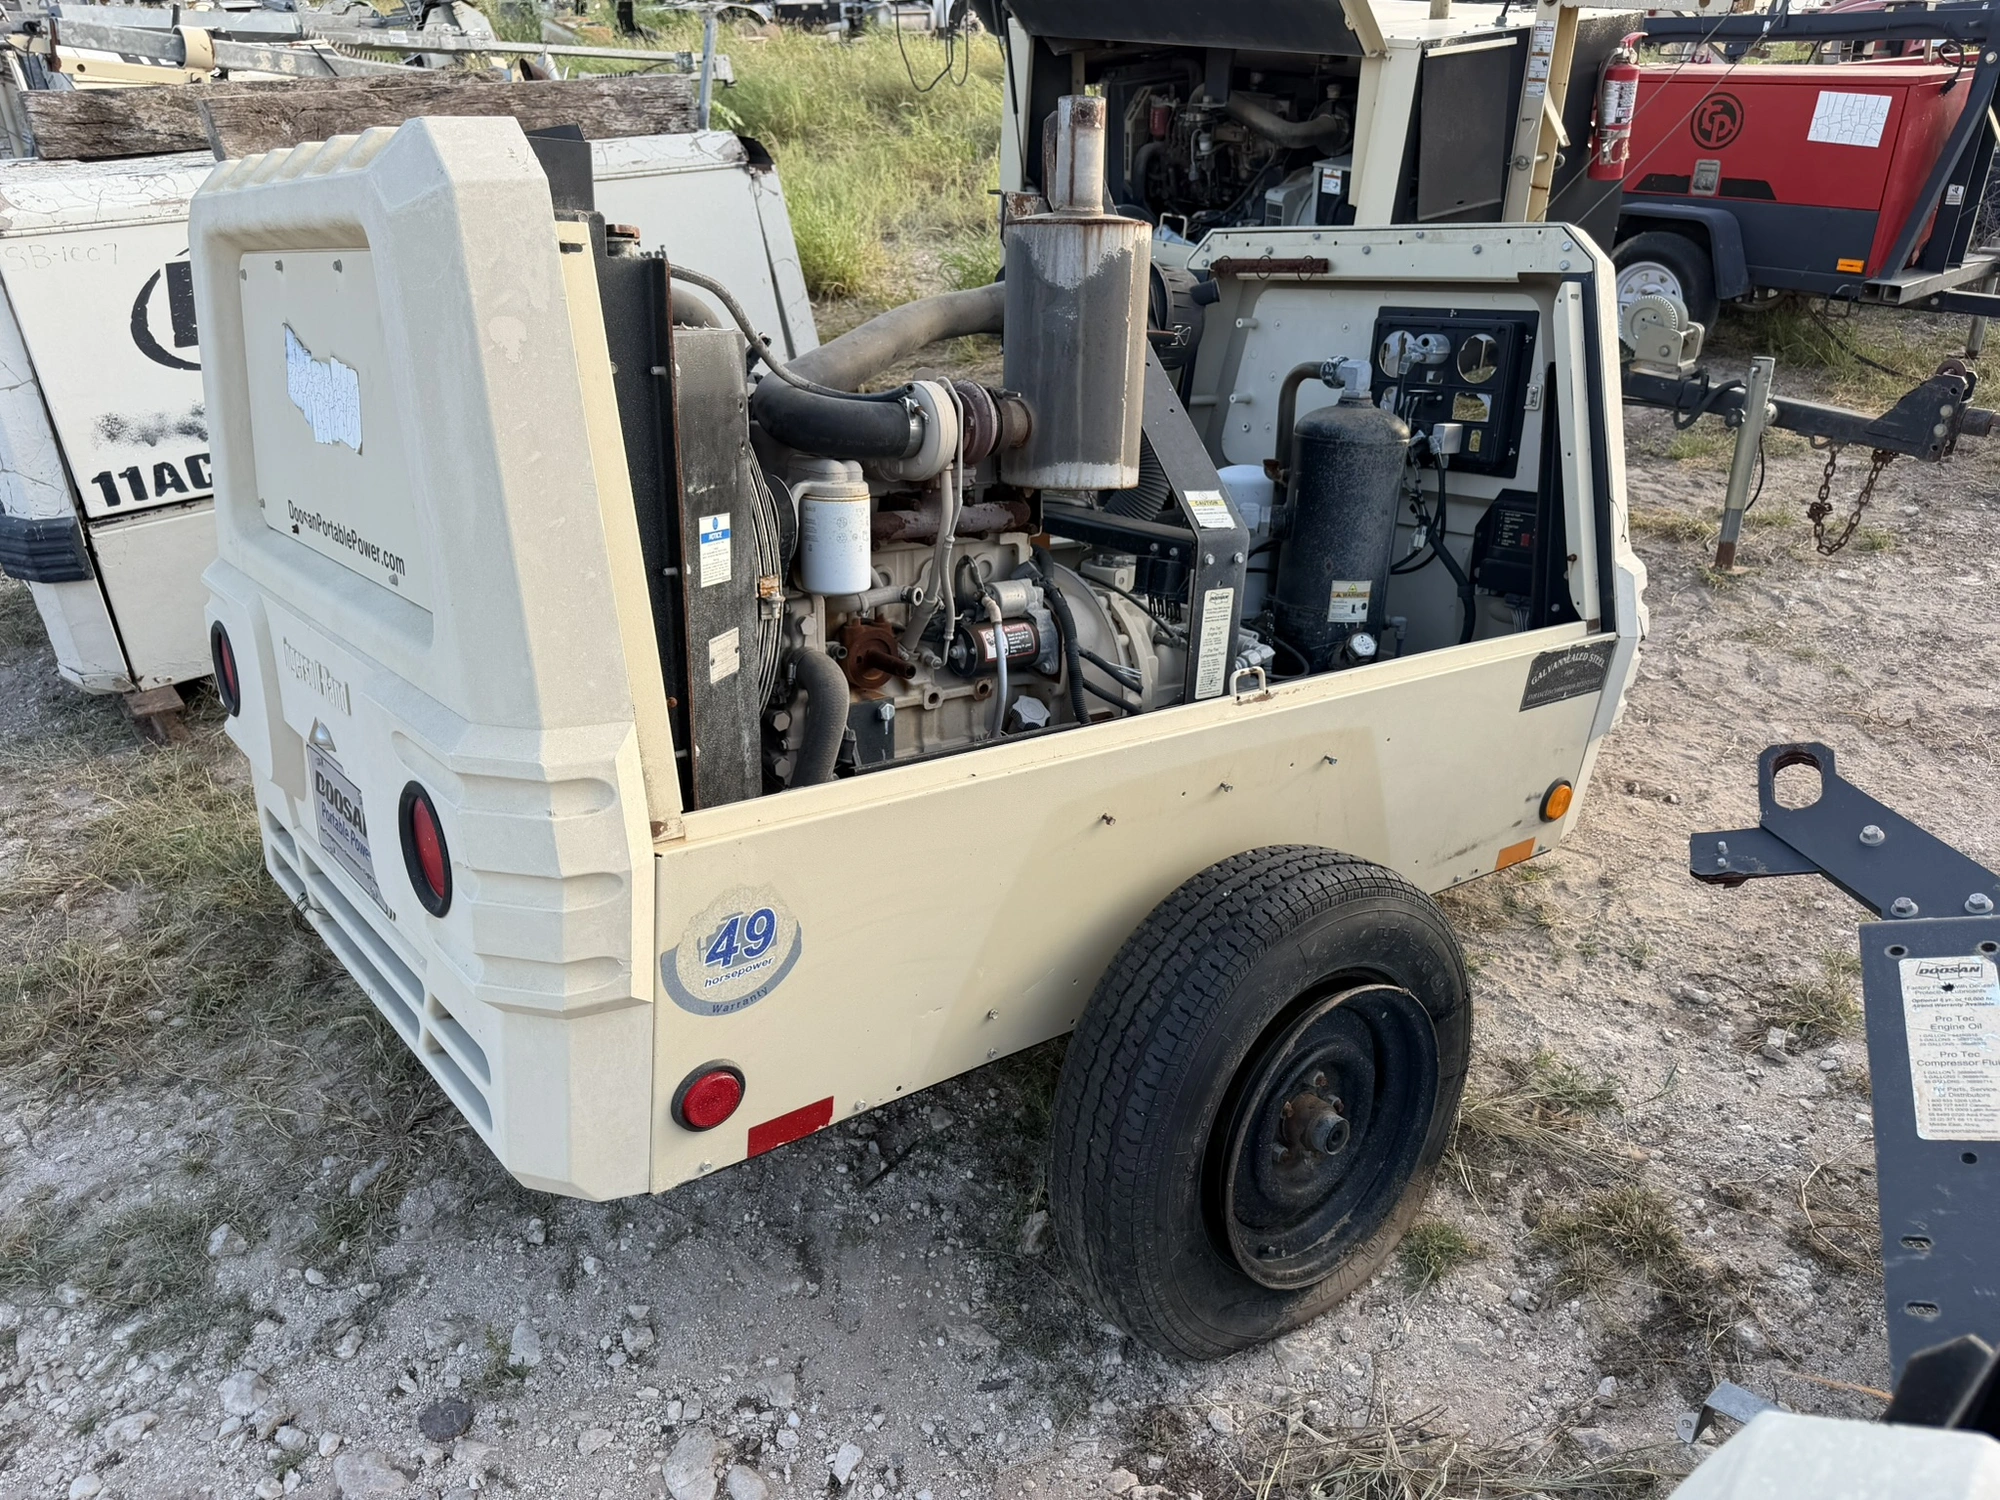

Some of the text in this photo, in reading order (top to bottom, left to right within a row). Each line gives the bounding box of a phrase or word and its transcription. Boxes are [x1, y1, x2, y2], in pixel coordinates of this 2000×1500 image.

[288, 500, 406, 576] DoosanPortablePower.com
[1588, 654, 1605, 668] STEEL
[322, 802, 350, 842] Portable
[350, 830, 371, 861] Powe
[703, 906, 777, 970] 49
[704, 957, 775, 988] horsepower
[1918, 966, 1980, 974] DOOSAN
[712, 986, 768, 1013] Warranty
